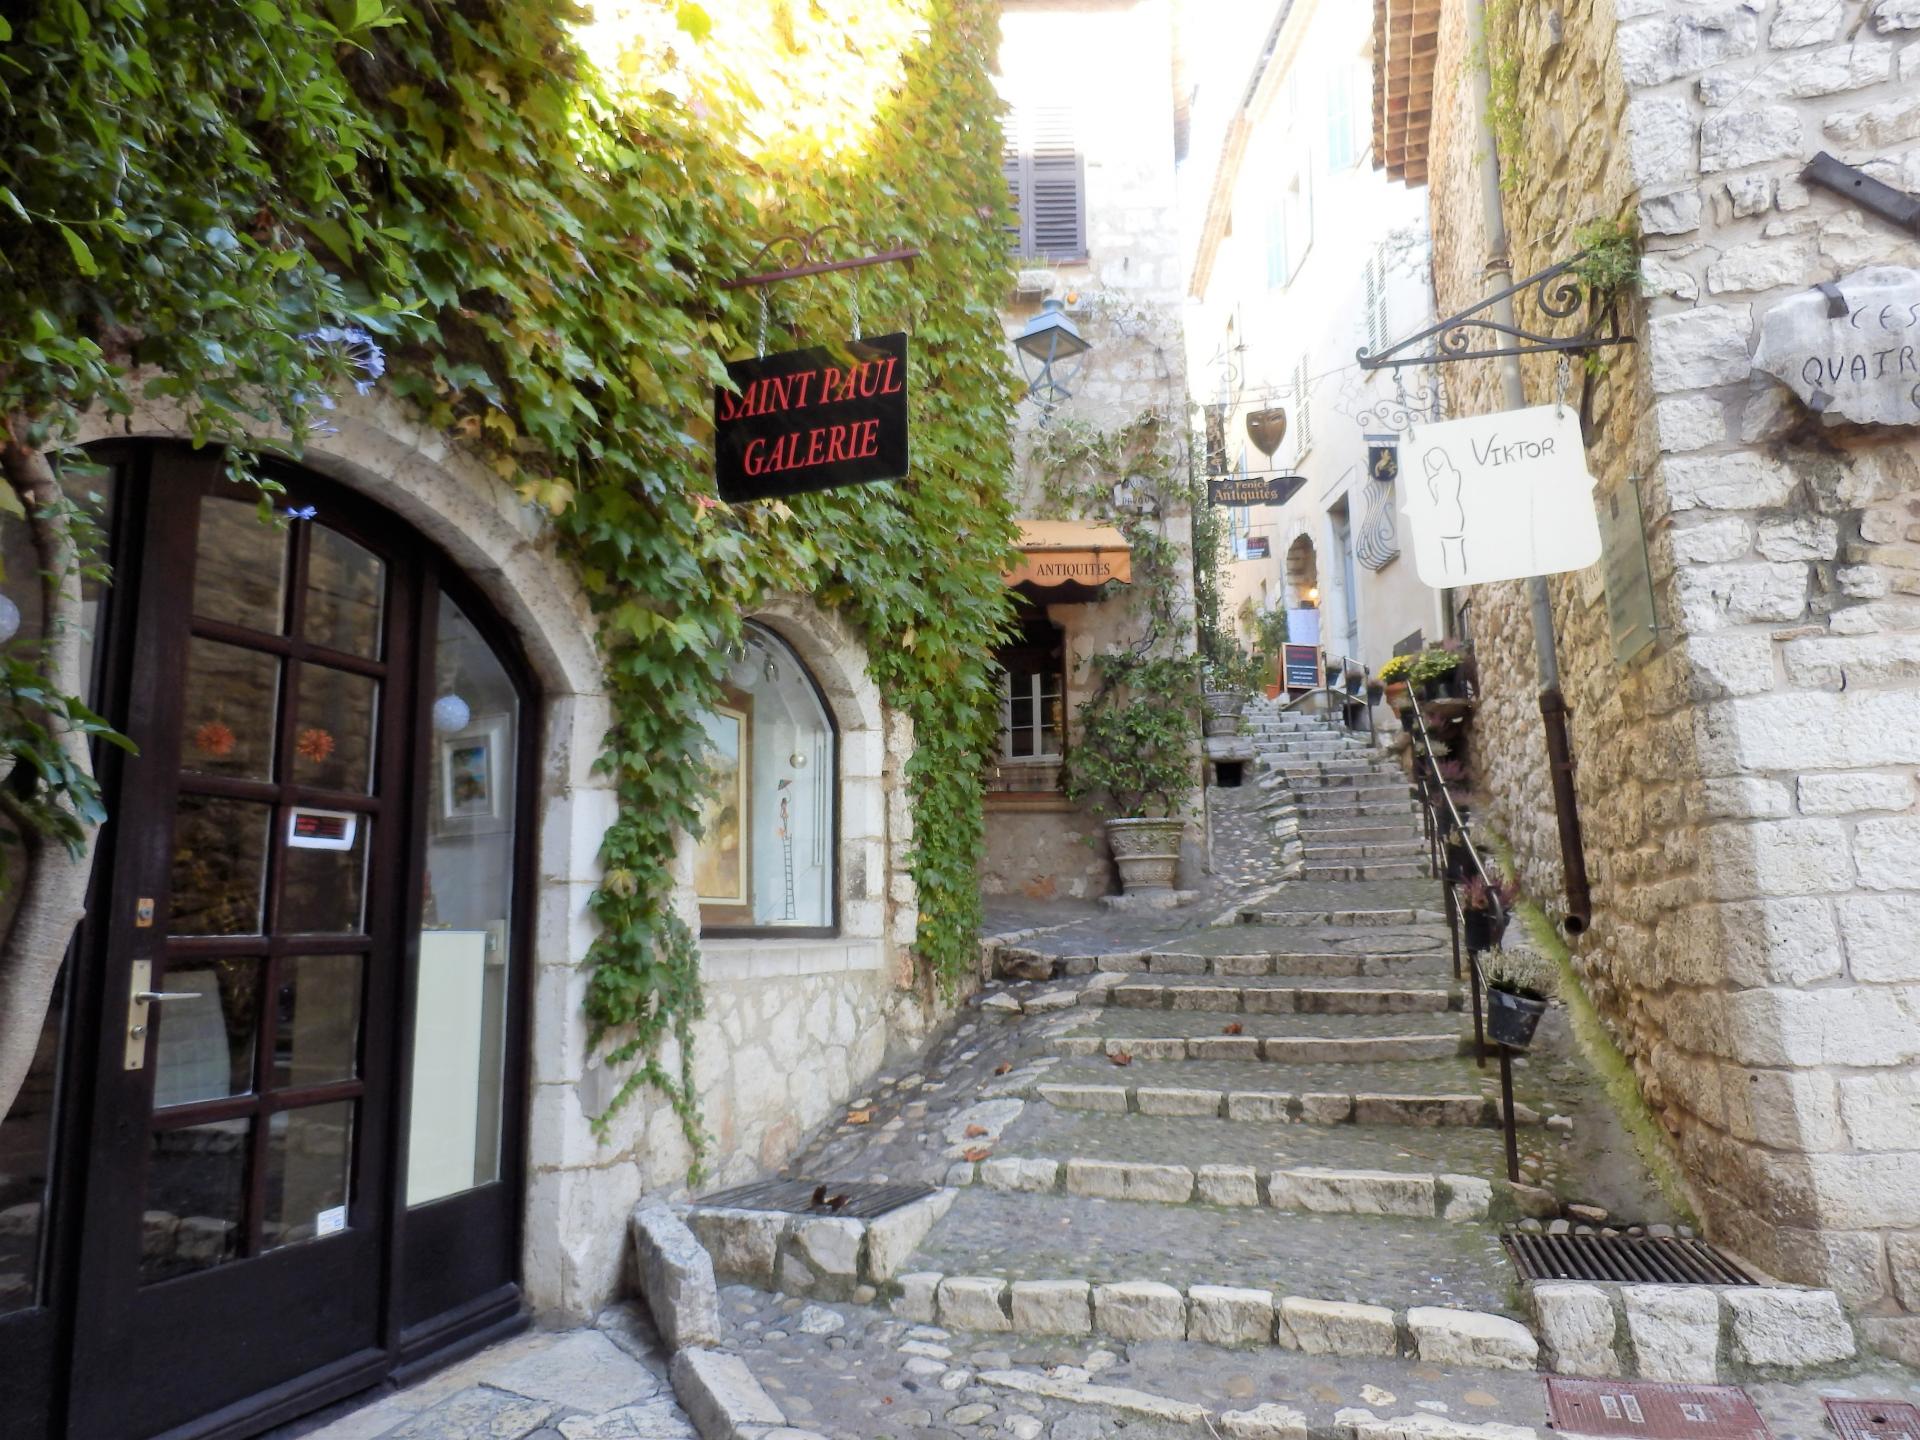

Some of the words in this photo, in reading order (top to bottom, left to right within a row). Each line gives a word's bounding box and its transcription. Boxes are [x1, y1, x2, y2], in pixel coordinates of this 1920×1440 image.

[719, 370, 816, 422] SAINT
[818, 356, 902, 406] PAUL
[743, 418, 881, 477] GALERIE
[1036, 562, 1110, 577] ANTIQUITES
